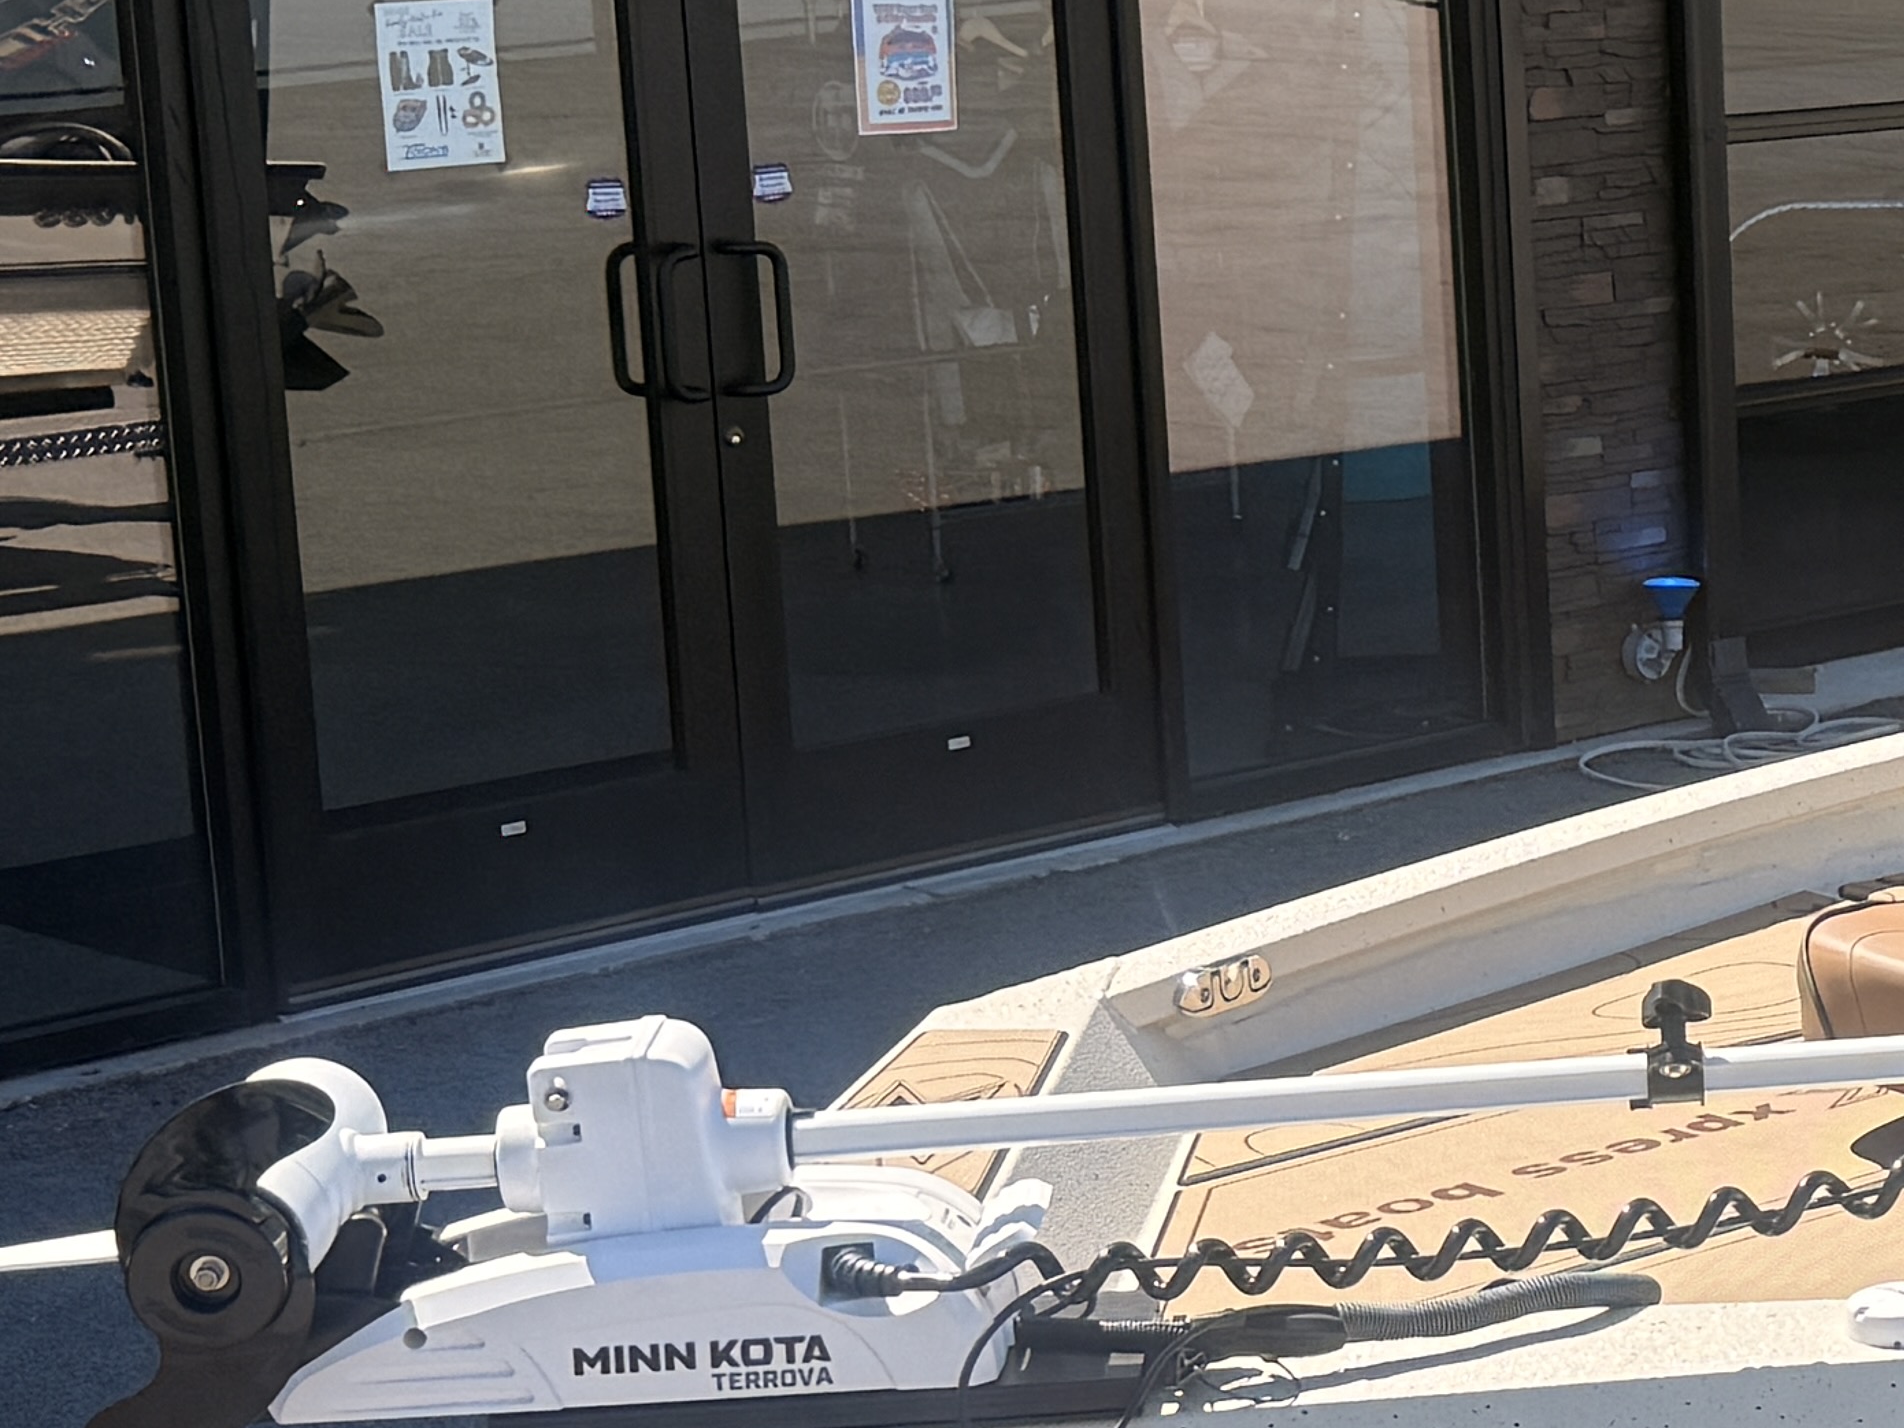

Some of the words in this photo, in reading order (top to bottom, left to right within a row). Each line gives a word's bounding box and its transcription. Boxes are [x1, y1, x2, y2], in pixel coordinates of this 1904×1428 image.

[572, 1341, 697, 1376] MINN
[709, 1334, 832, 1369] KOTA
[711, 1366, 834, 1392] TERROVA
